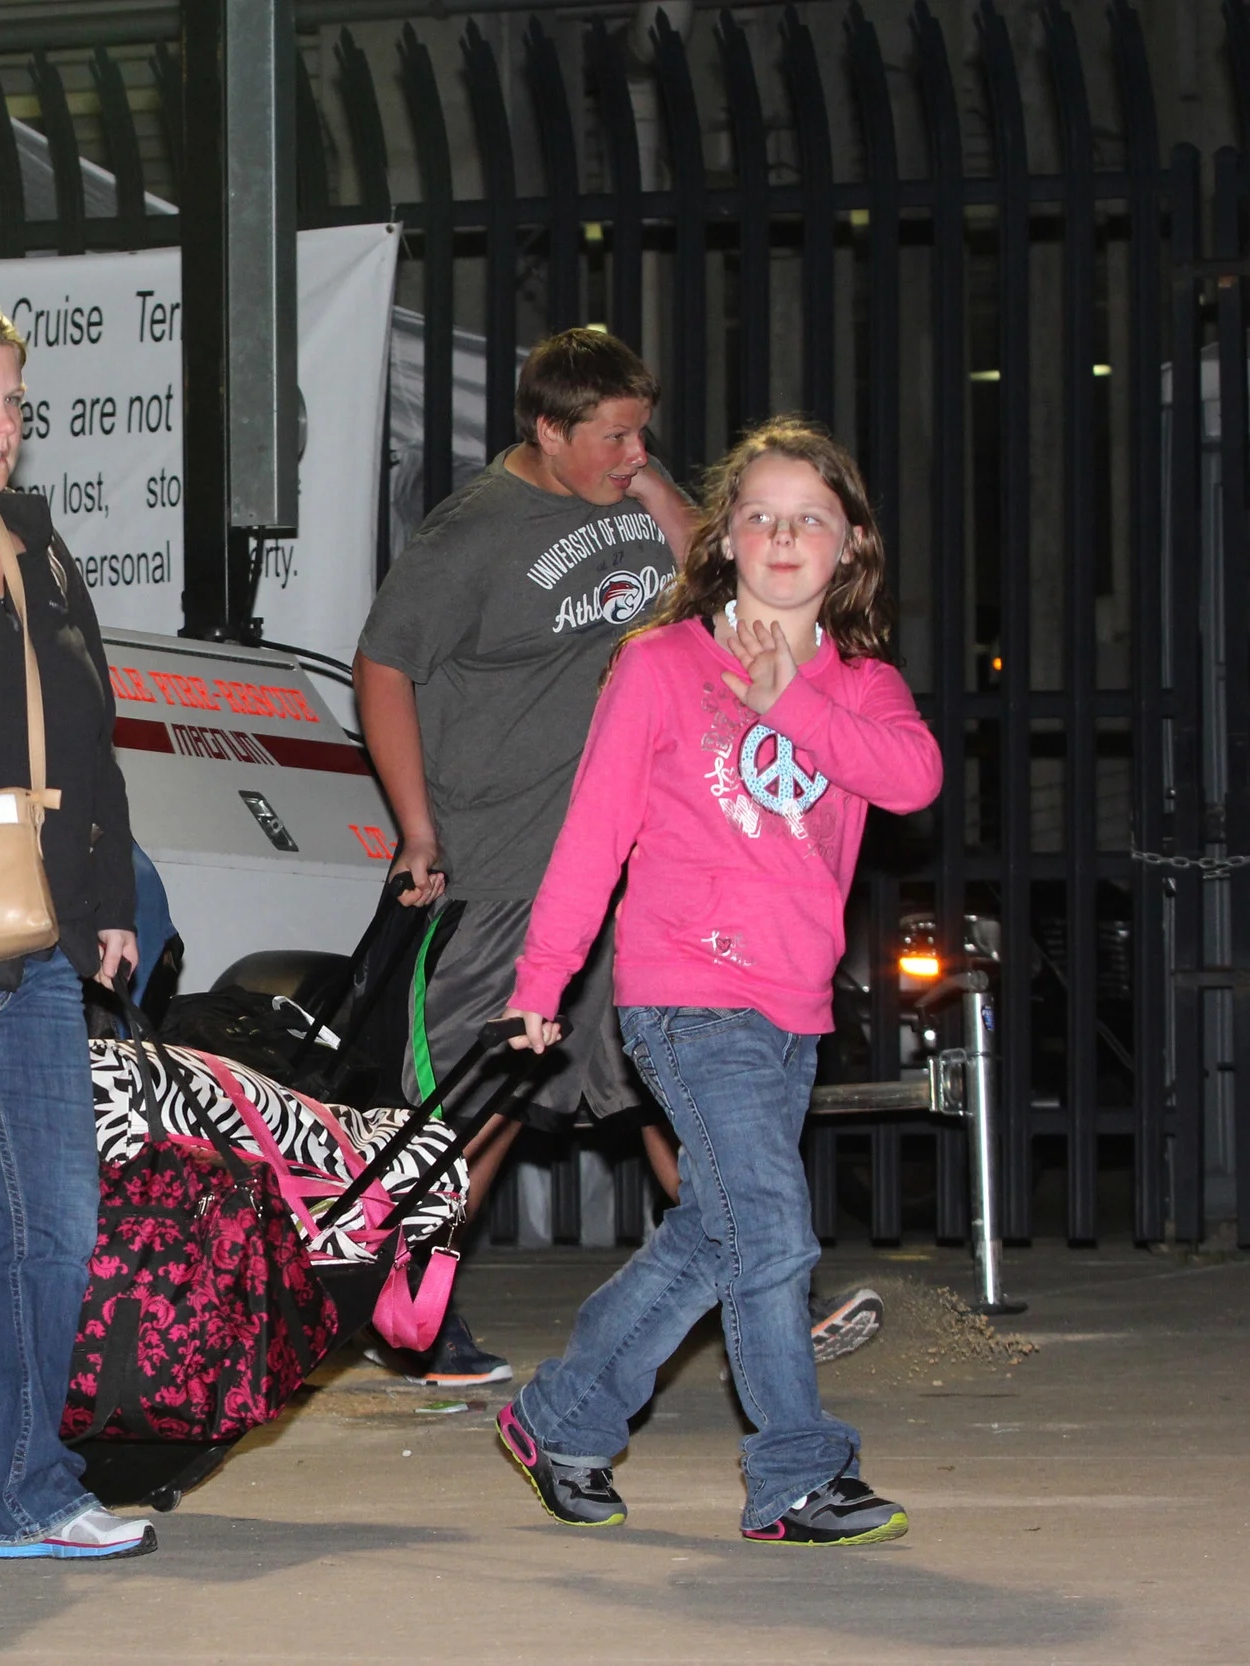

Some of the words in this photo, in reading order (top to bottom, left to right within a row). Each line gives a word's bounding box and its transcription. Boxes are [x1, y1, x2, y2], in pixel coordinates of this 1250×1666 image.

[12, 294, 103, 348] Cruise
[136, 289, 183, 344] Ter
[70, 396, 117, 438] are
[127, 383, 174, 434] not
[63, 471, 109, 519] lost,
[146, 467, 182, 509] sto
[526, 522, 603, 591] UNIVERSITY
[597, 517, 617, 546] OF
[147, 670, 320, 723] FIRE-RESCUE
[170, 722, 275, 766] MAGNUM
[348, 823, 398, 861] LT-
